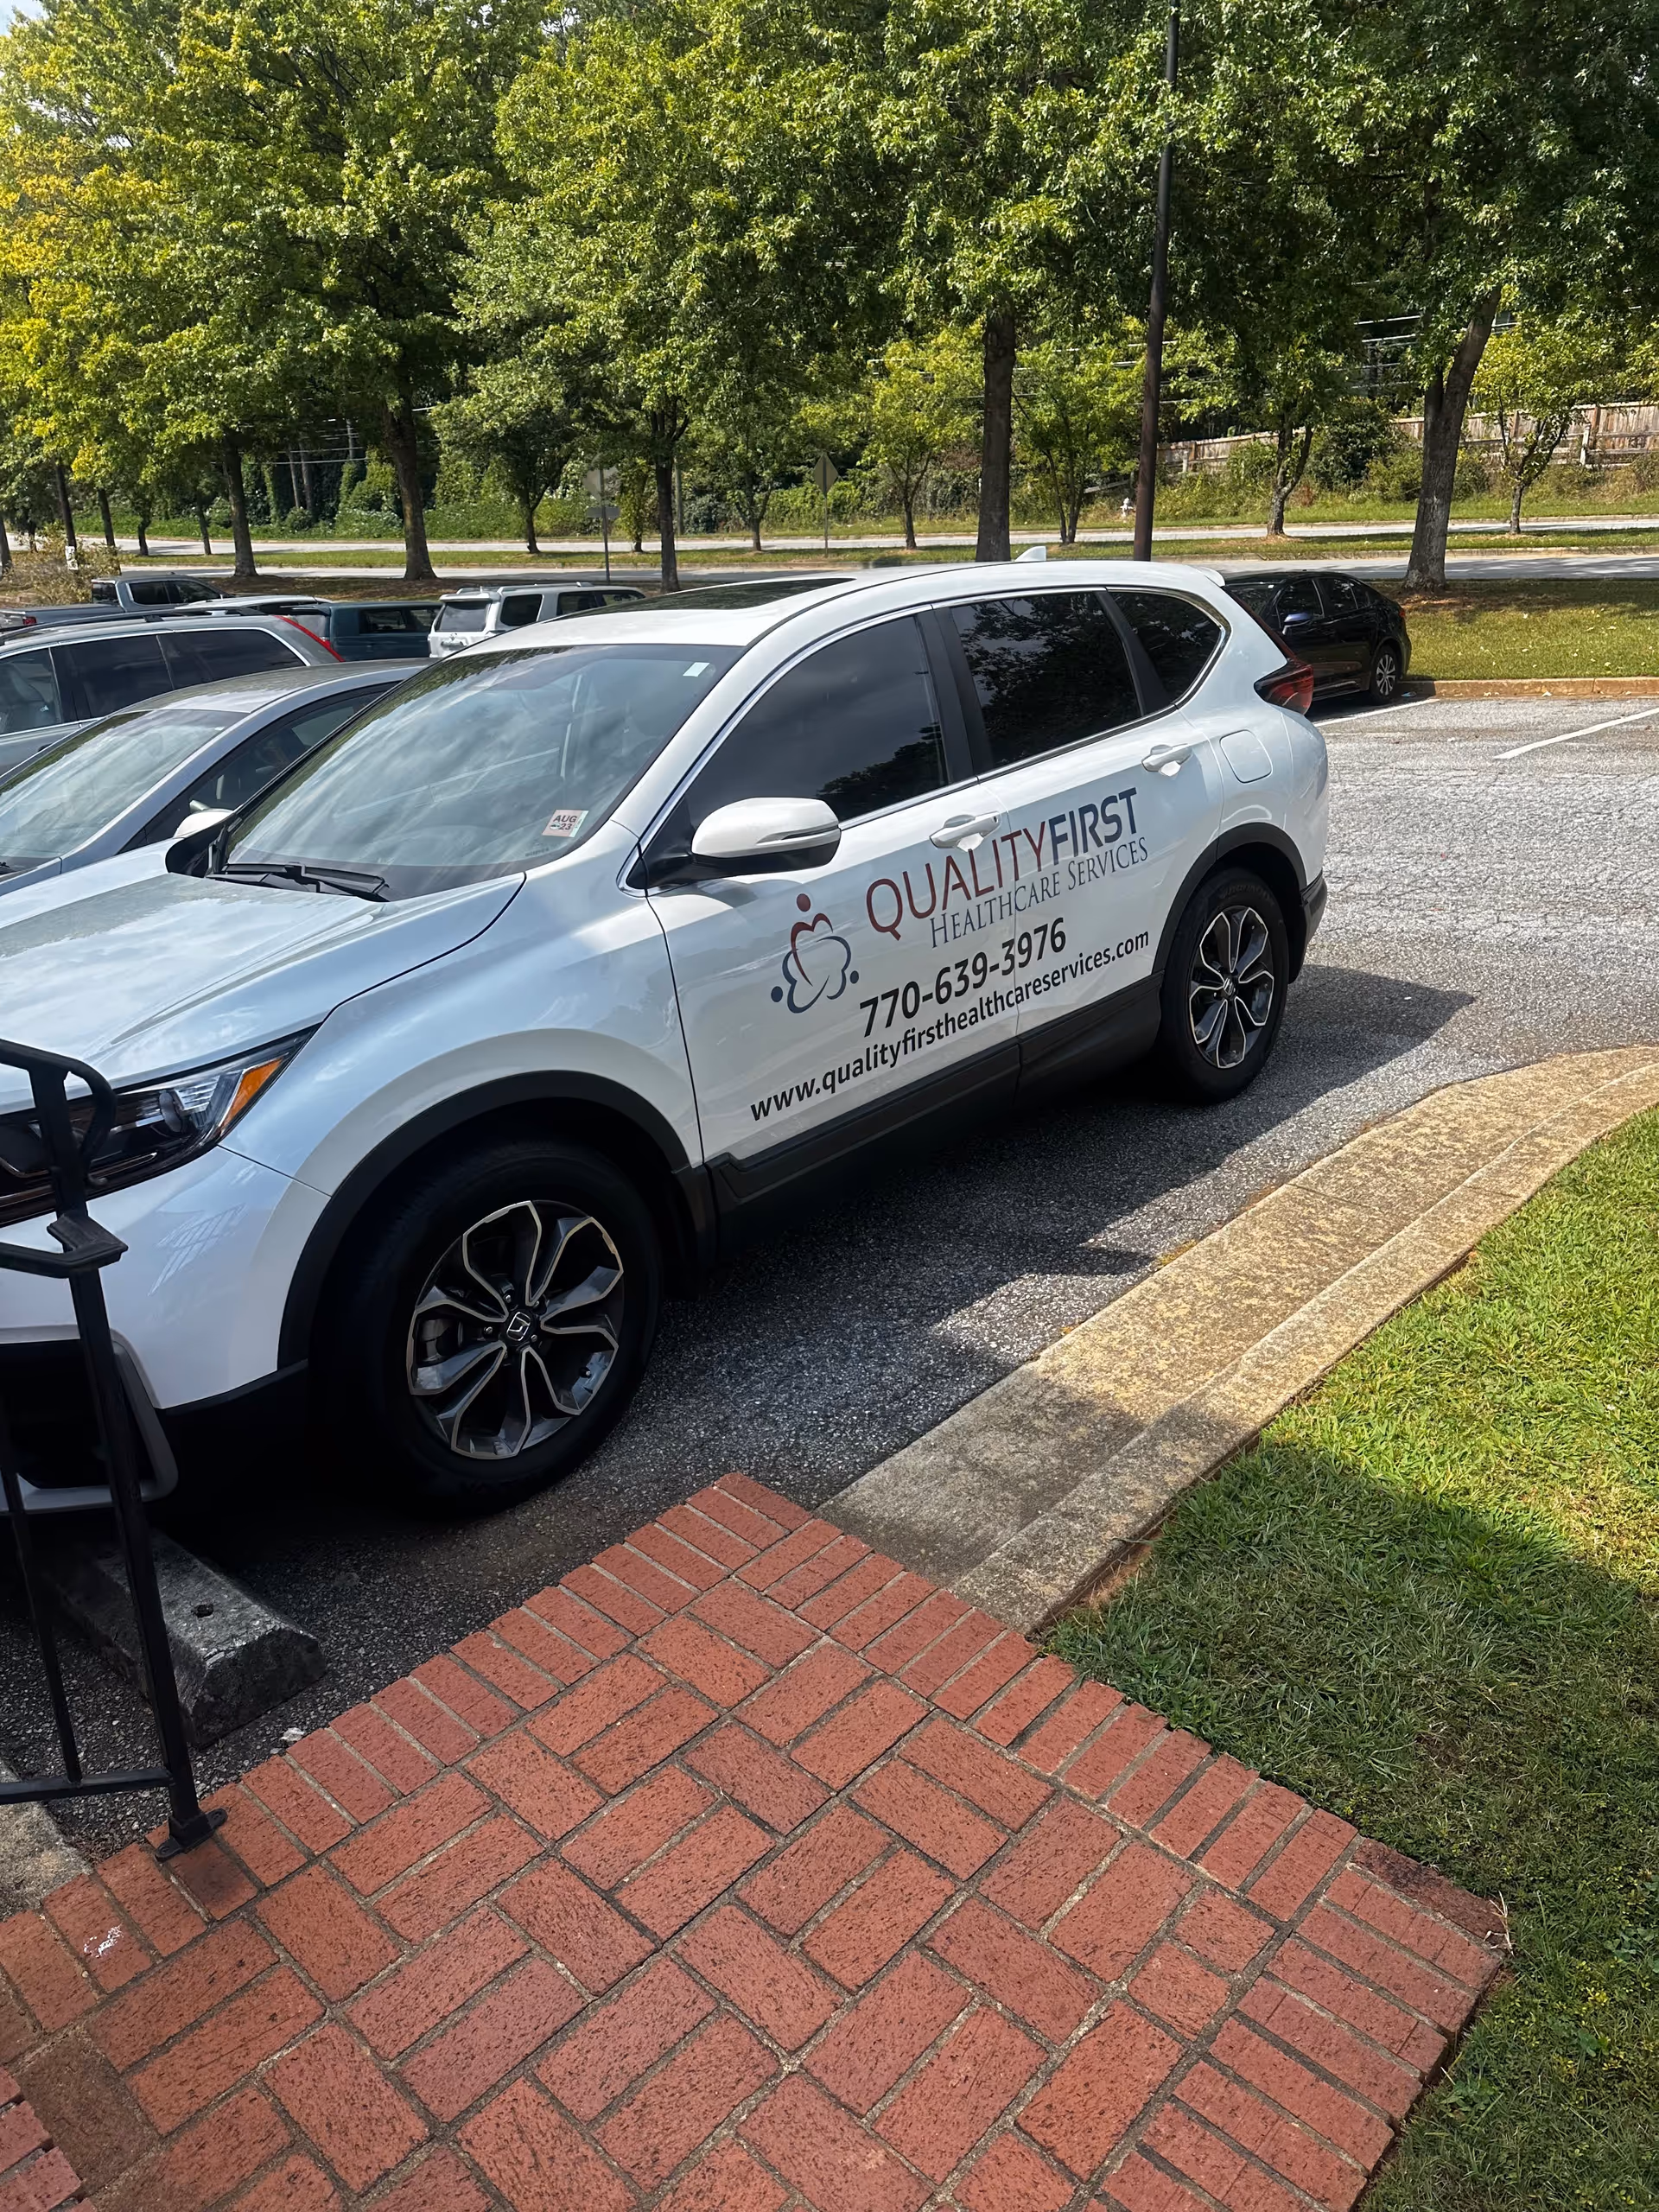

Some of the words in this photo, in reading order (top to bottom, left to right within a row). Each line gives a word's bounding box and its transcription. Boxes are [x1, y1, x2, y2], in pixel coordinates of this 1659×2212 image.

[866, 787, 1138, 941] QUALITYFIRST
[930, 870, 1061, 948] HEALTHCARE
[1068, 836, 1148, 891] SERVICES
[750, 929, 1149, 1122] www.qualityfirsthealthcareservices.com
[859, 917, 1067, 1038] 770-639-3976
